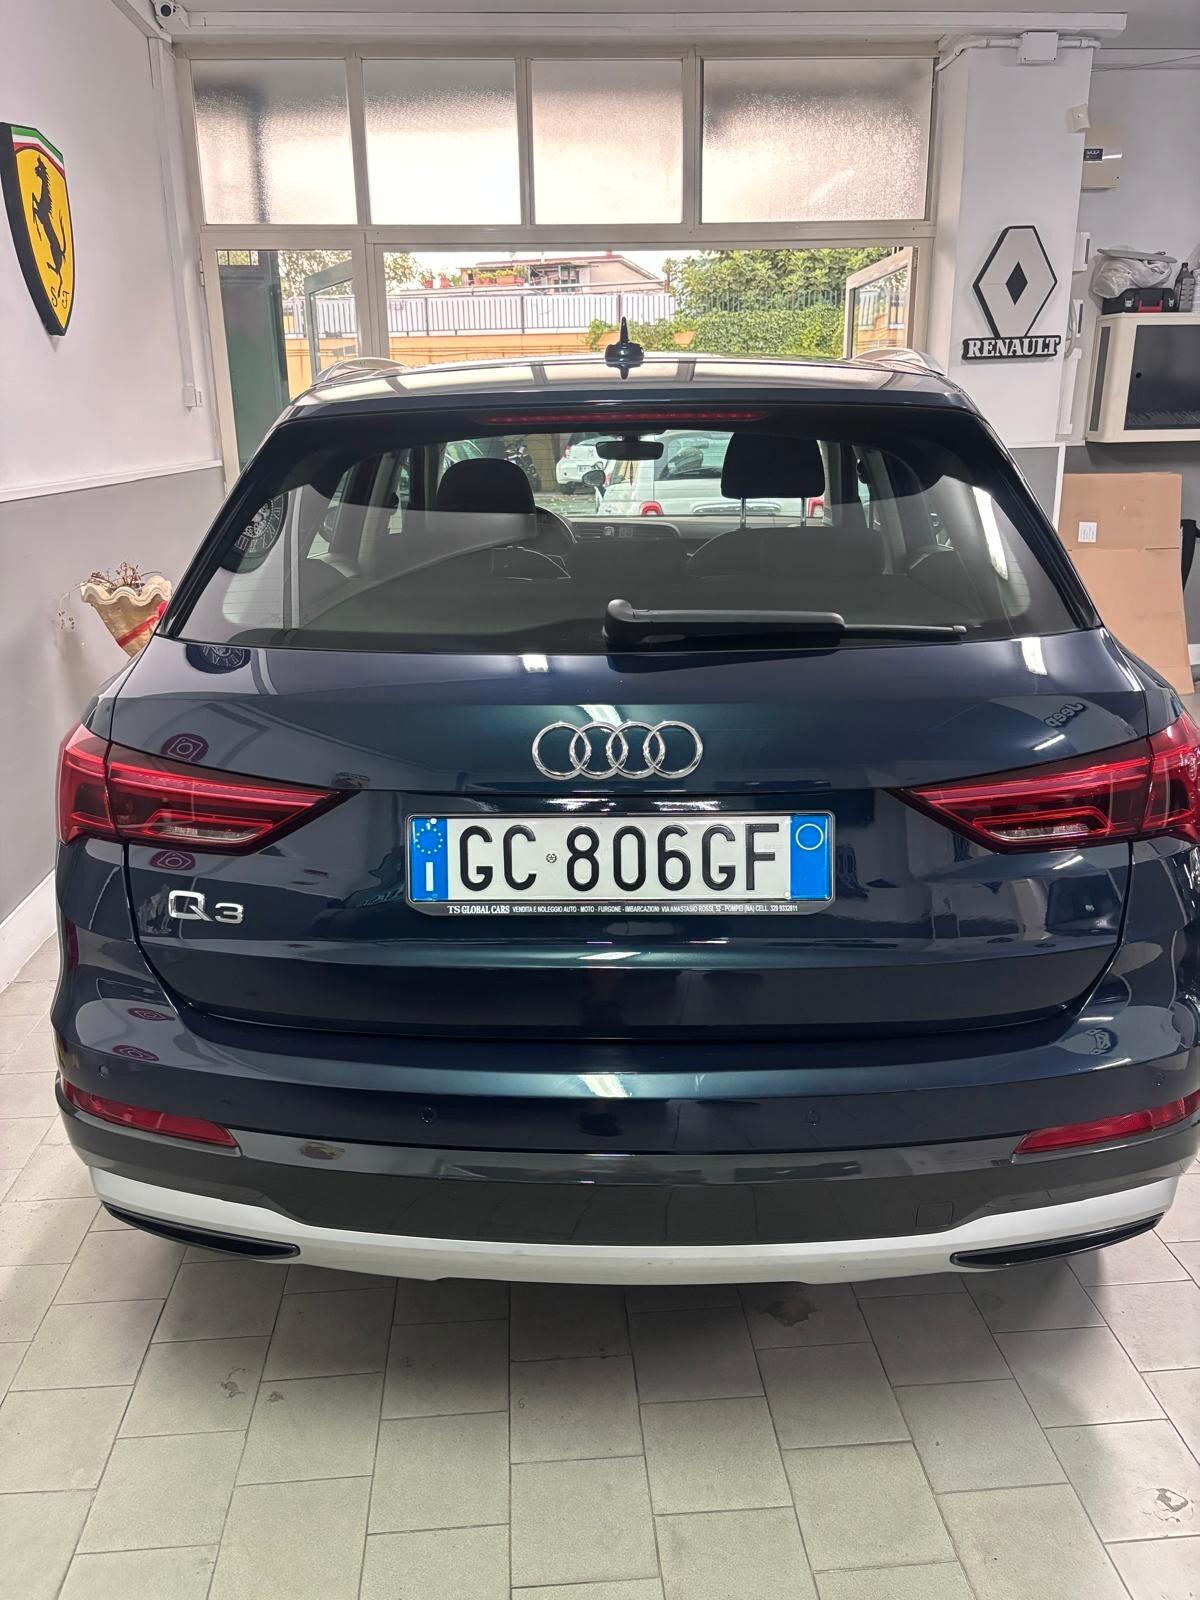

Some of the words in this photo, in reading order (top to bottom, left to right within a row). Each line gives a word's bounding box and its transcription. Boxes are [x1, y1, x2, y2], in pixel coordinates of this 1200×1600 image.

[966, 337, 1060, 358] RENAULT
[459, 824, 537, 891] GC
[566, 823, 780, 891] 806GF
[168, 889, 244, 924] Q3
[447, 905, 460, 914] TS
[461, 905, 490, 914] GLOBAL
[491, 905, 510, 914] CARS
[512, 905, 533, 913] VENDITA
[537, 905, 563, 913] NOLEGGIO
[563, 905, 577, 913] AUTO
[580, 905, 595, 913] MOTO
[598, 905, 622, 913] FURGONE
[625, 905, 660, 913] IMBARCAZIONI
[661, 905, 670, 913] VIA
[670, 905, 698, 913] ANASTASIO
[725, 904, 744, 912] POMPEI
